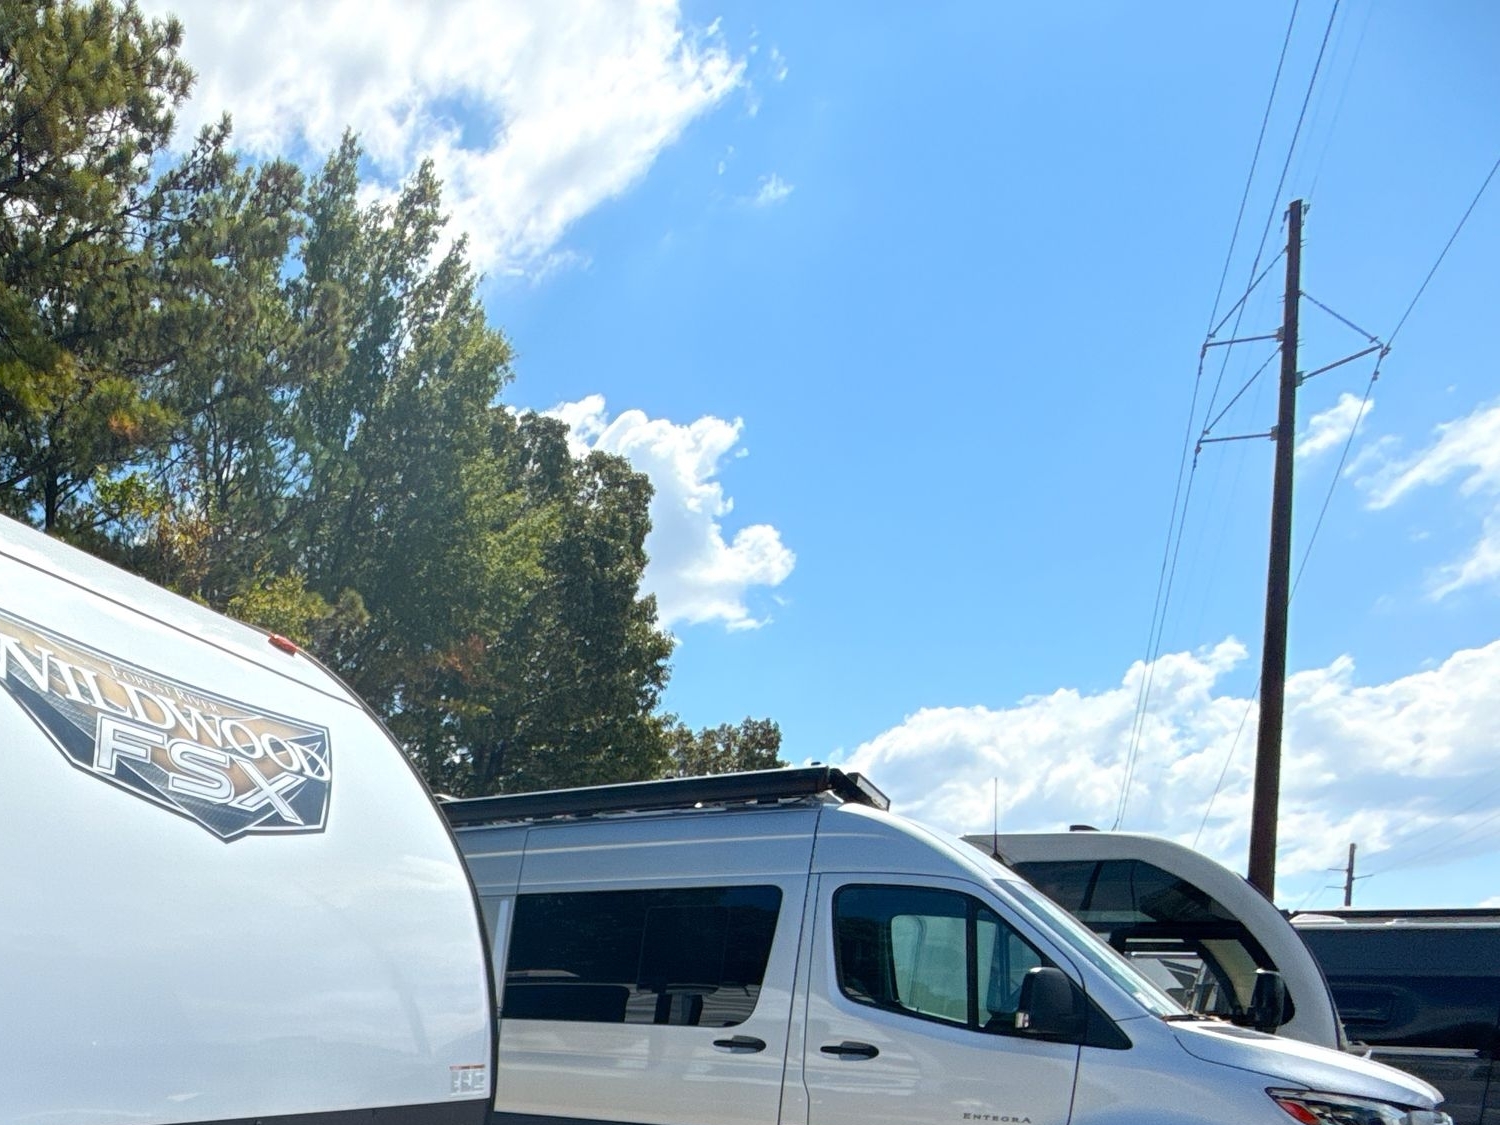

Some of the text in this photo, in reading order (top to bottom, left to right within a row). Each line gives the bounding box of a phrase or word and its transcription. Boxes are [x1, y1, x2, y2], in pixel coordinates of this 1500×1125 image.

[111, 665, 221, 714] FOREST RIVER
[93, 715, 305, 826] FSX
[962, 1112, 1032, 1124] ENTEGRA
